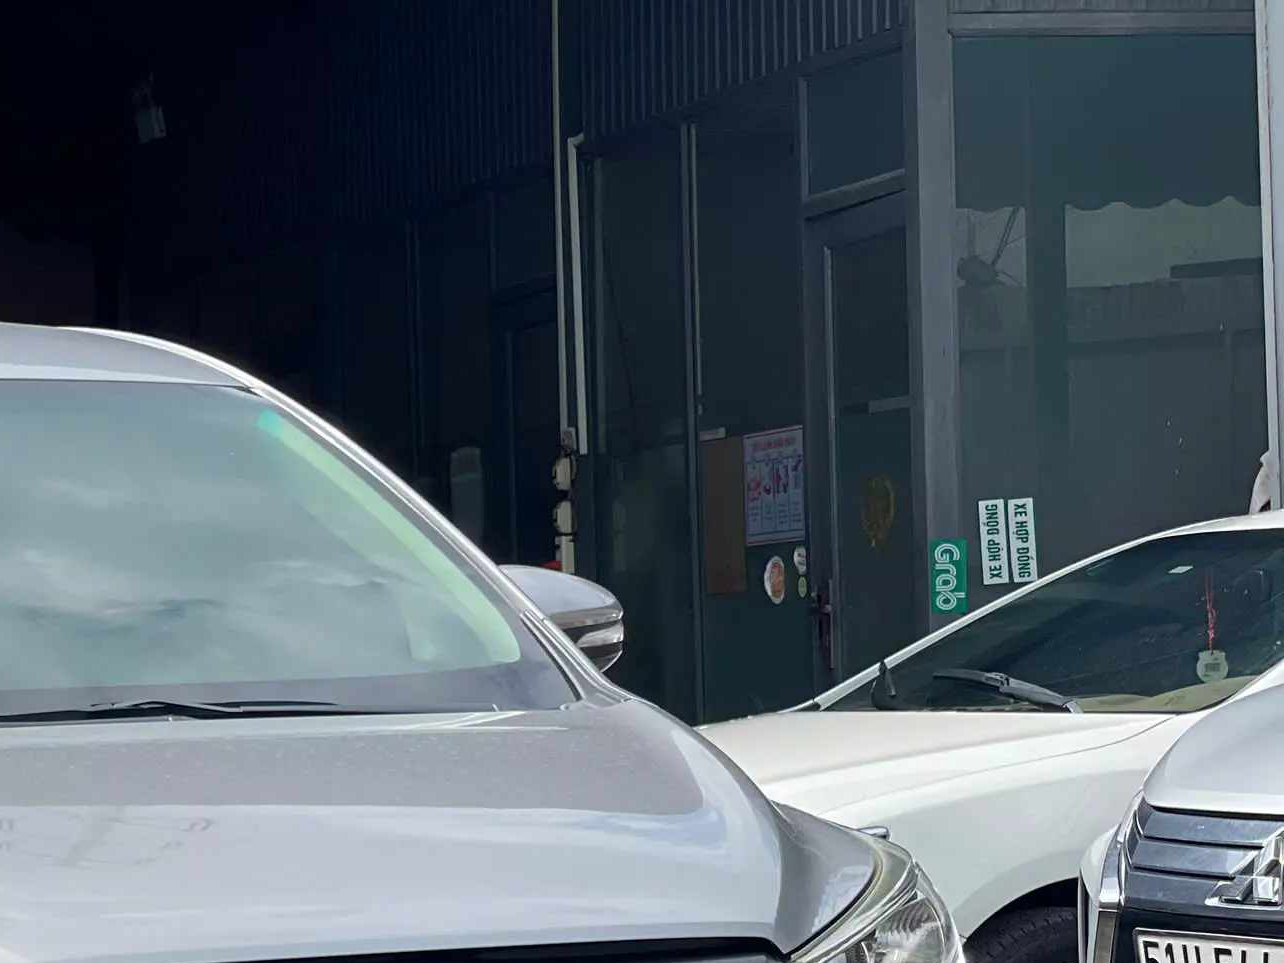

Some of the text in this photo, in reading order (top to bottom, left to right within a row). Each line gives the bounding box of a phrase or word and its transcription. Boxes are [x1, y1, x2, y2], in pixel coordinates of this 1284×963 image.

[1014, 503, 1028, 517] XE
[934, 543, 966, 611] Grab
[989, 564, 1003, 580] XE
